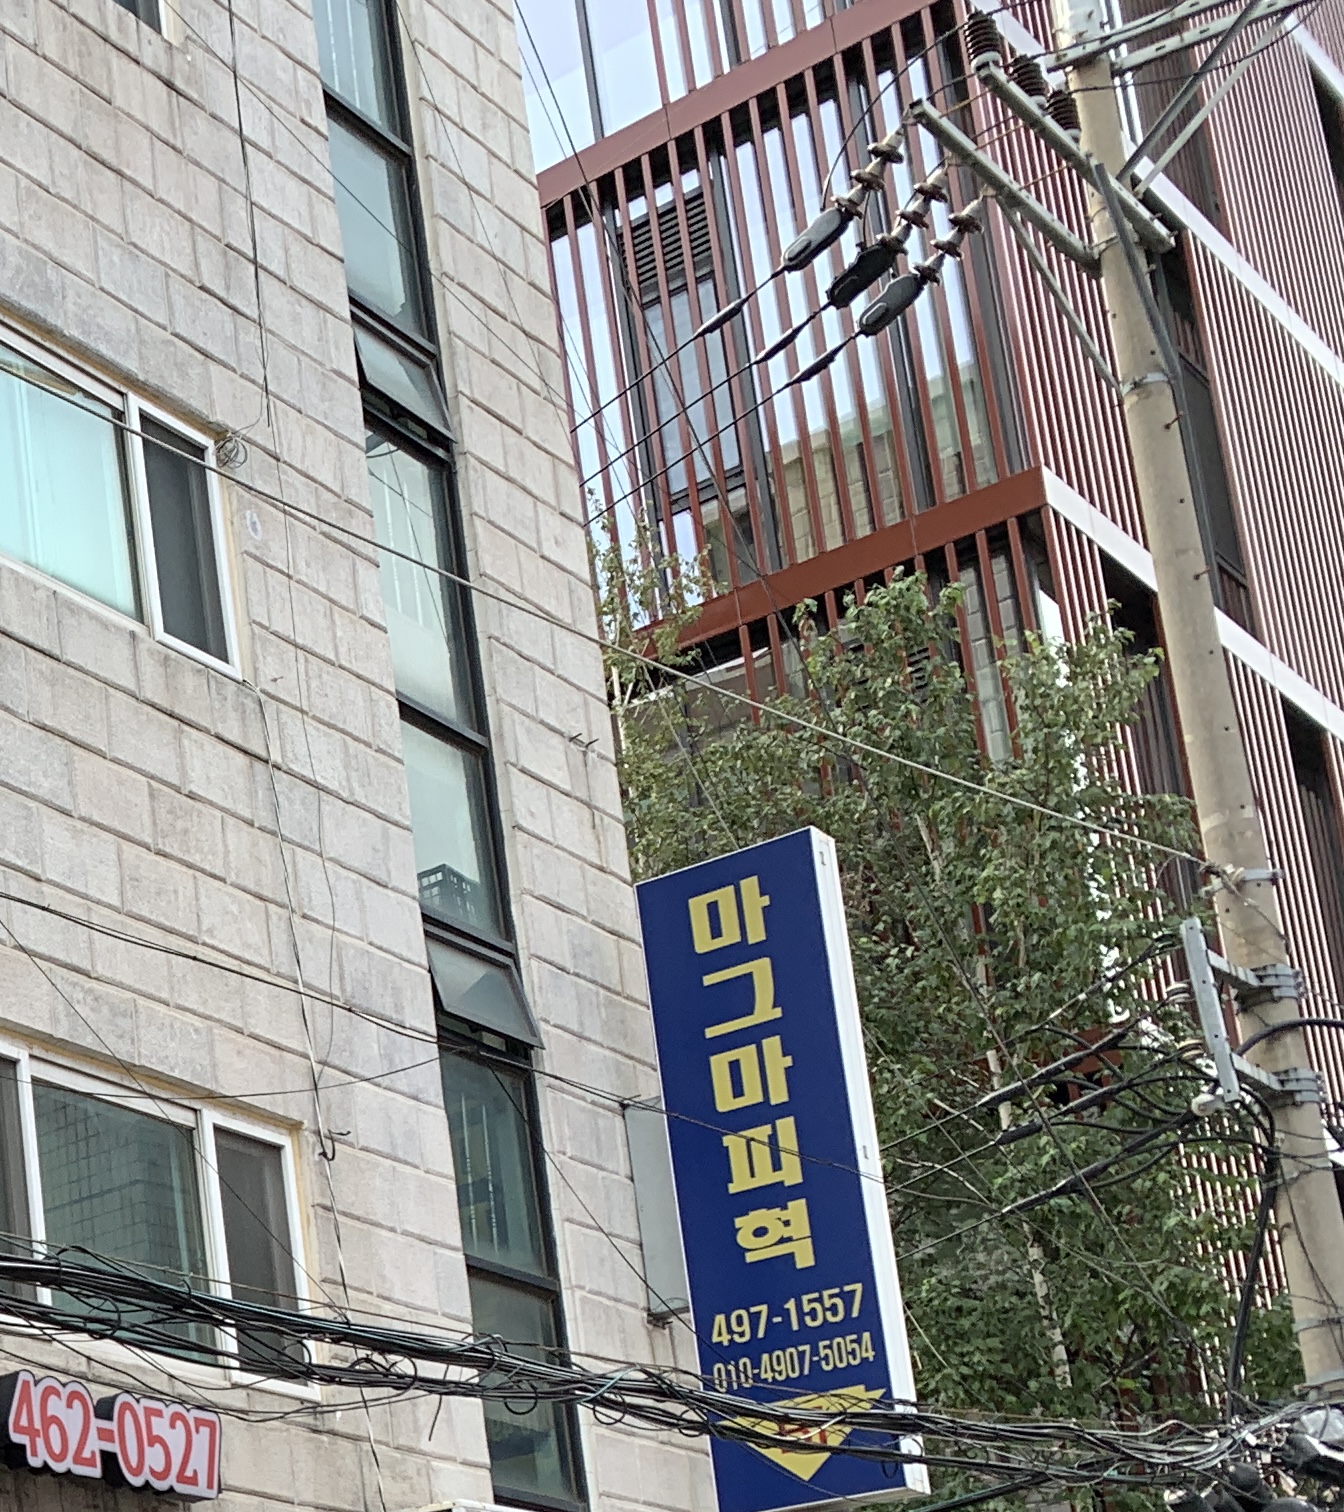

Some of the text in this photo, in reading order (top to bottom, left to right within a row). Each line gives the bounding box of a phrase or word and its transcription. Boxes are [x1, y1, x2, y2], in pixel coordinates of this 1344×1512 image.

[687, 875, 815, 1269] 마그마피혁
[711, 1283, 863, 1346] 497-1557
[713, 1331, 876, 1394] 010-4907-5054
[11, 1373, 219, 1496] 462-0527
